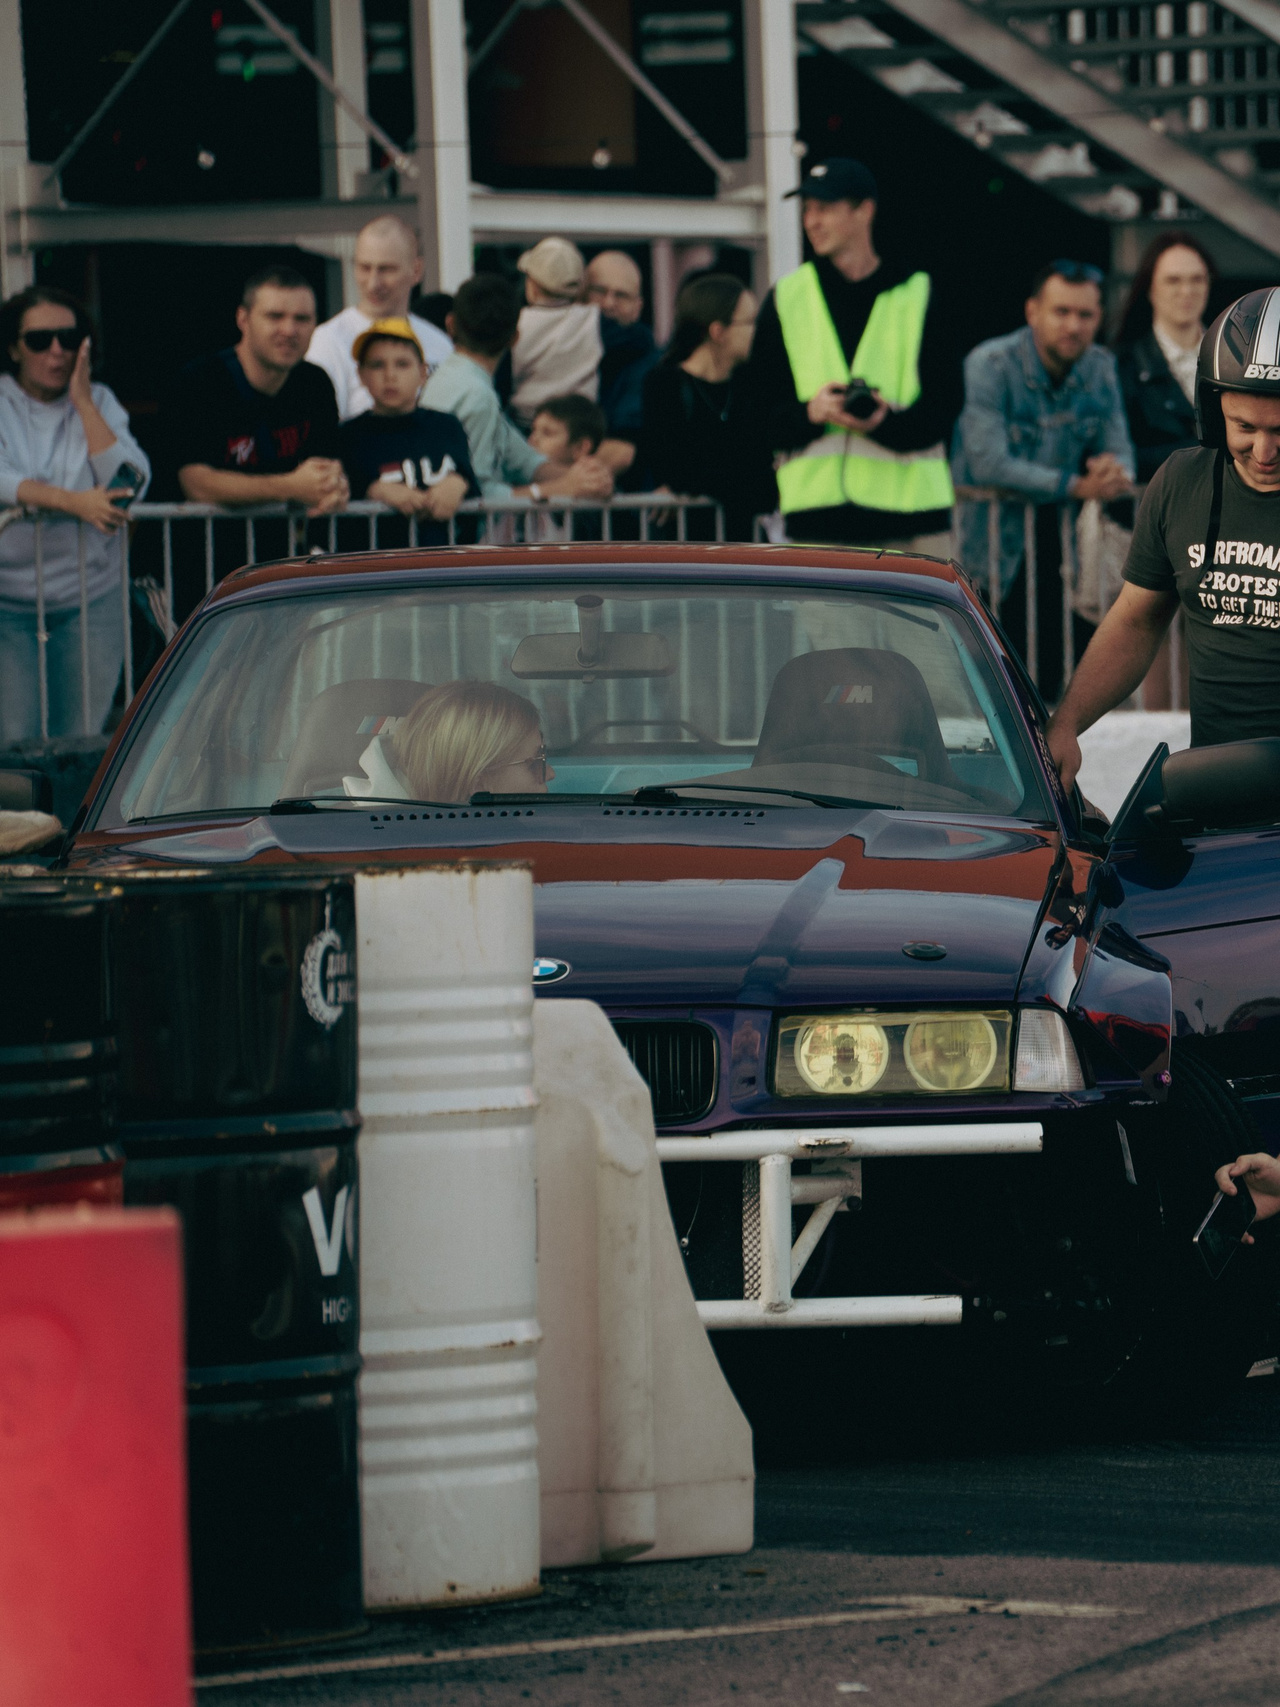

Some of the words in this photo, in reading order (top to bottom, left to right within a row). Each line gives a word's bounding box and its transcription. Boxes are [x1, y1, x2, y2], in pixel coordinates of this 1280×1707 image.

[1198, 592, 1218, 610] TO
[1221, 595, 1248, 613] GET
[1212, 611, 1244, 625] since
[302, 1185, 355, 1277] V
